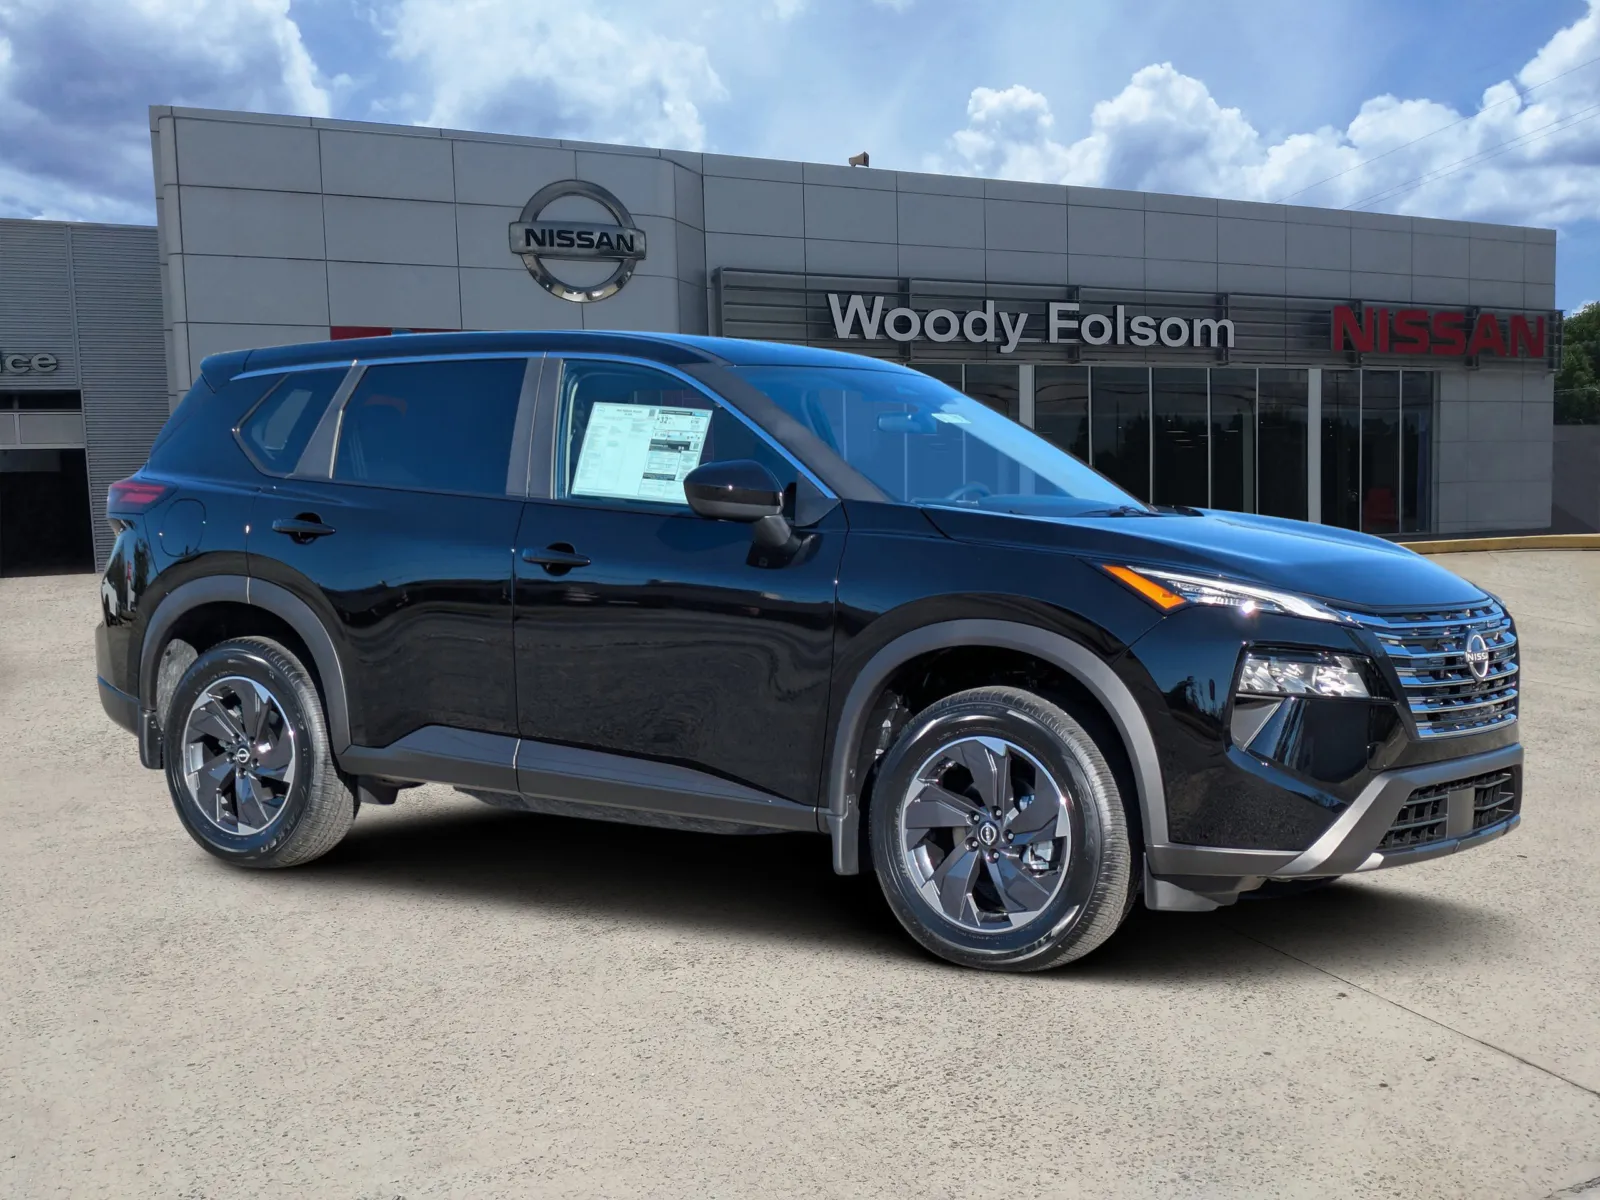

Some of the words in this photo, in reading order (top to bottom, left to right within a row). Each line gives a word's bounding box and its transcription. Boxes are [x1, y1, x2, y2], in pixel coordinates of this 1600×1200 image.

[524, 228, 635, 253] NISSAN
[826, 293, 1029, 354] Woody
[1047, 301, 1236, 348] Folsom
[1332, 304, 1545, 359] NISSAN
[0, 353, 58, 373] ce
